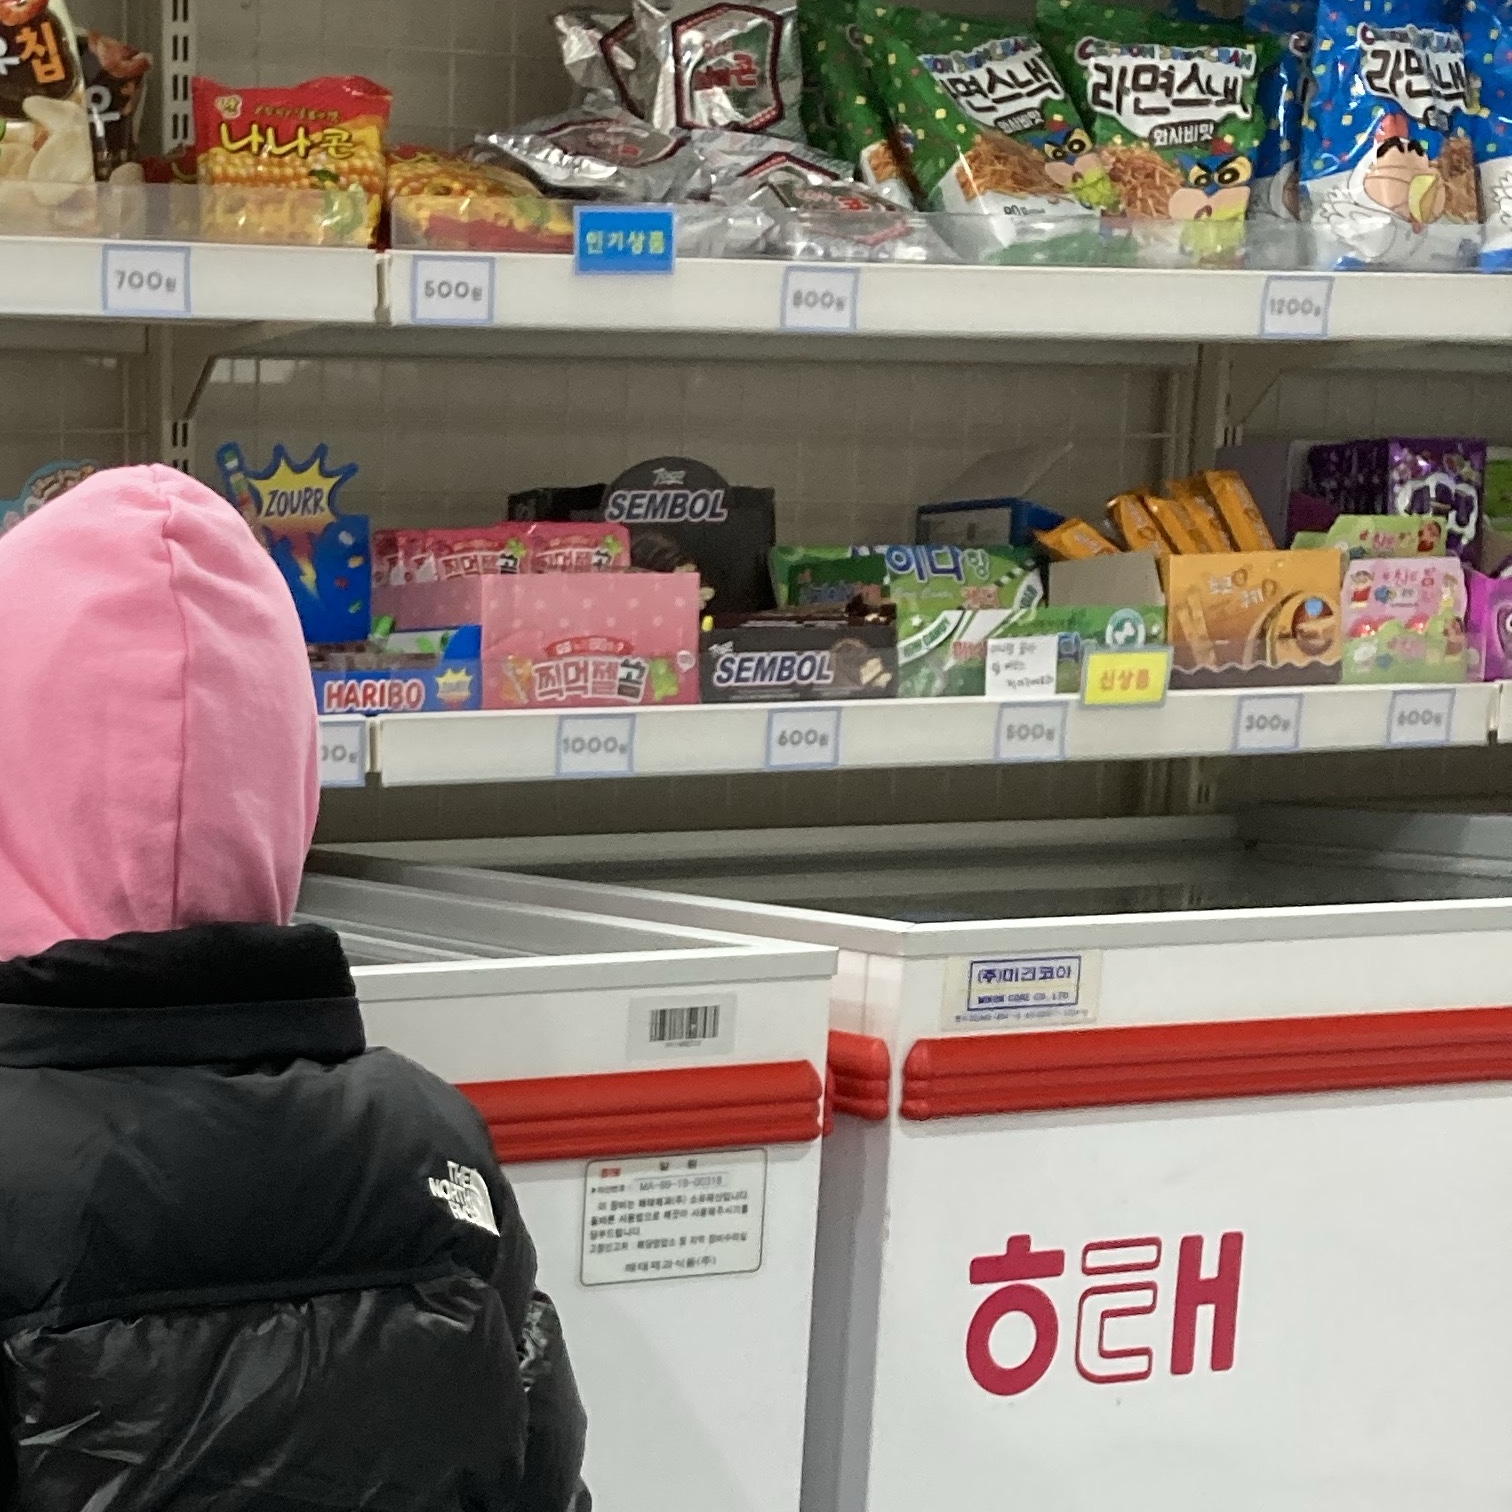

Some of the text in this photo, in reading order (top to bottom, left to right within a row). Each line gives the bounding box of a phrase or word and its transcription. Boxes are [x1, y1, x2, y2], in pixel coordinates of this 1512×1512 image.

[938, 57, 1062, 113] 면스낵
[1091, 62, 1249, 116] 라면스낵
[219, 121, 355, 160] 나나콘
[265, 486, 326, 516] ZOURR
[604, 489, 728, 523] SEMBOL
[713, 651, 834, 688] SEMBOL
[324, 678, 425, 713] HARIBO
